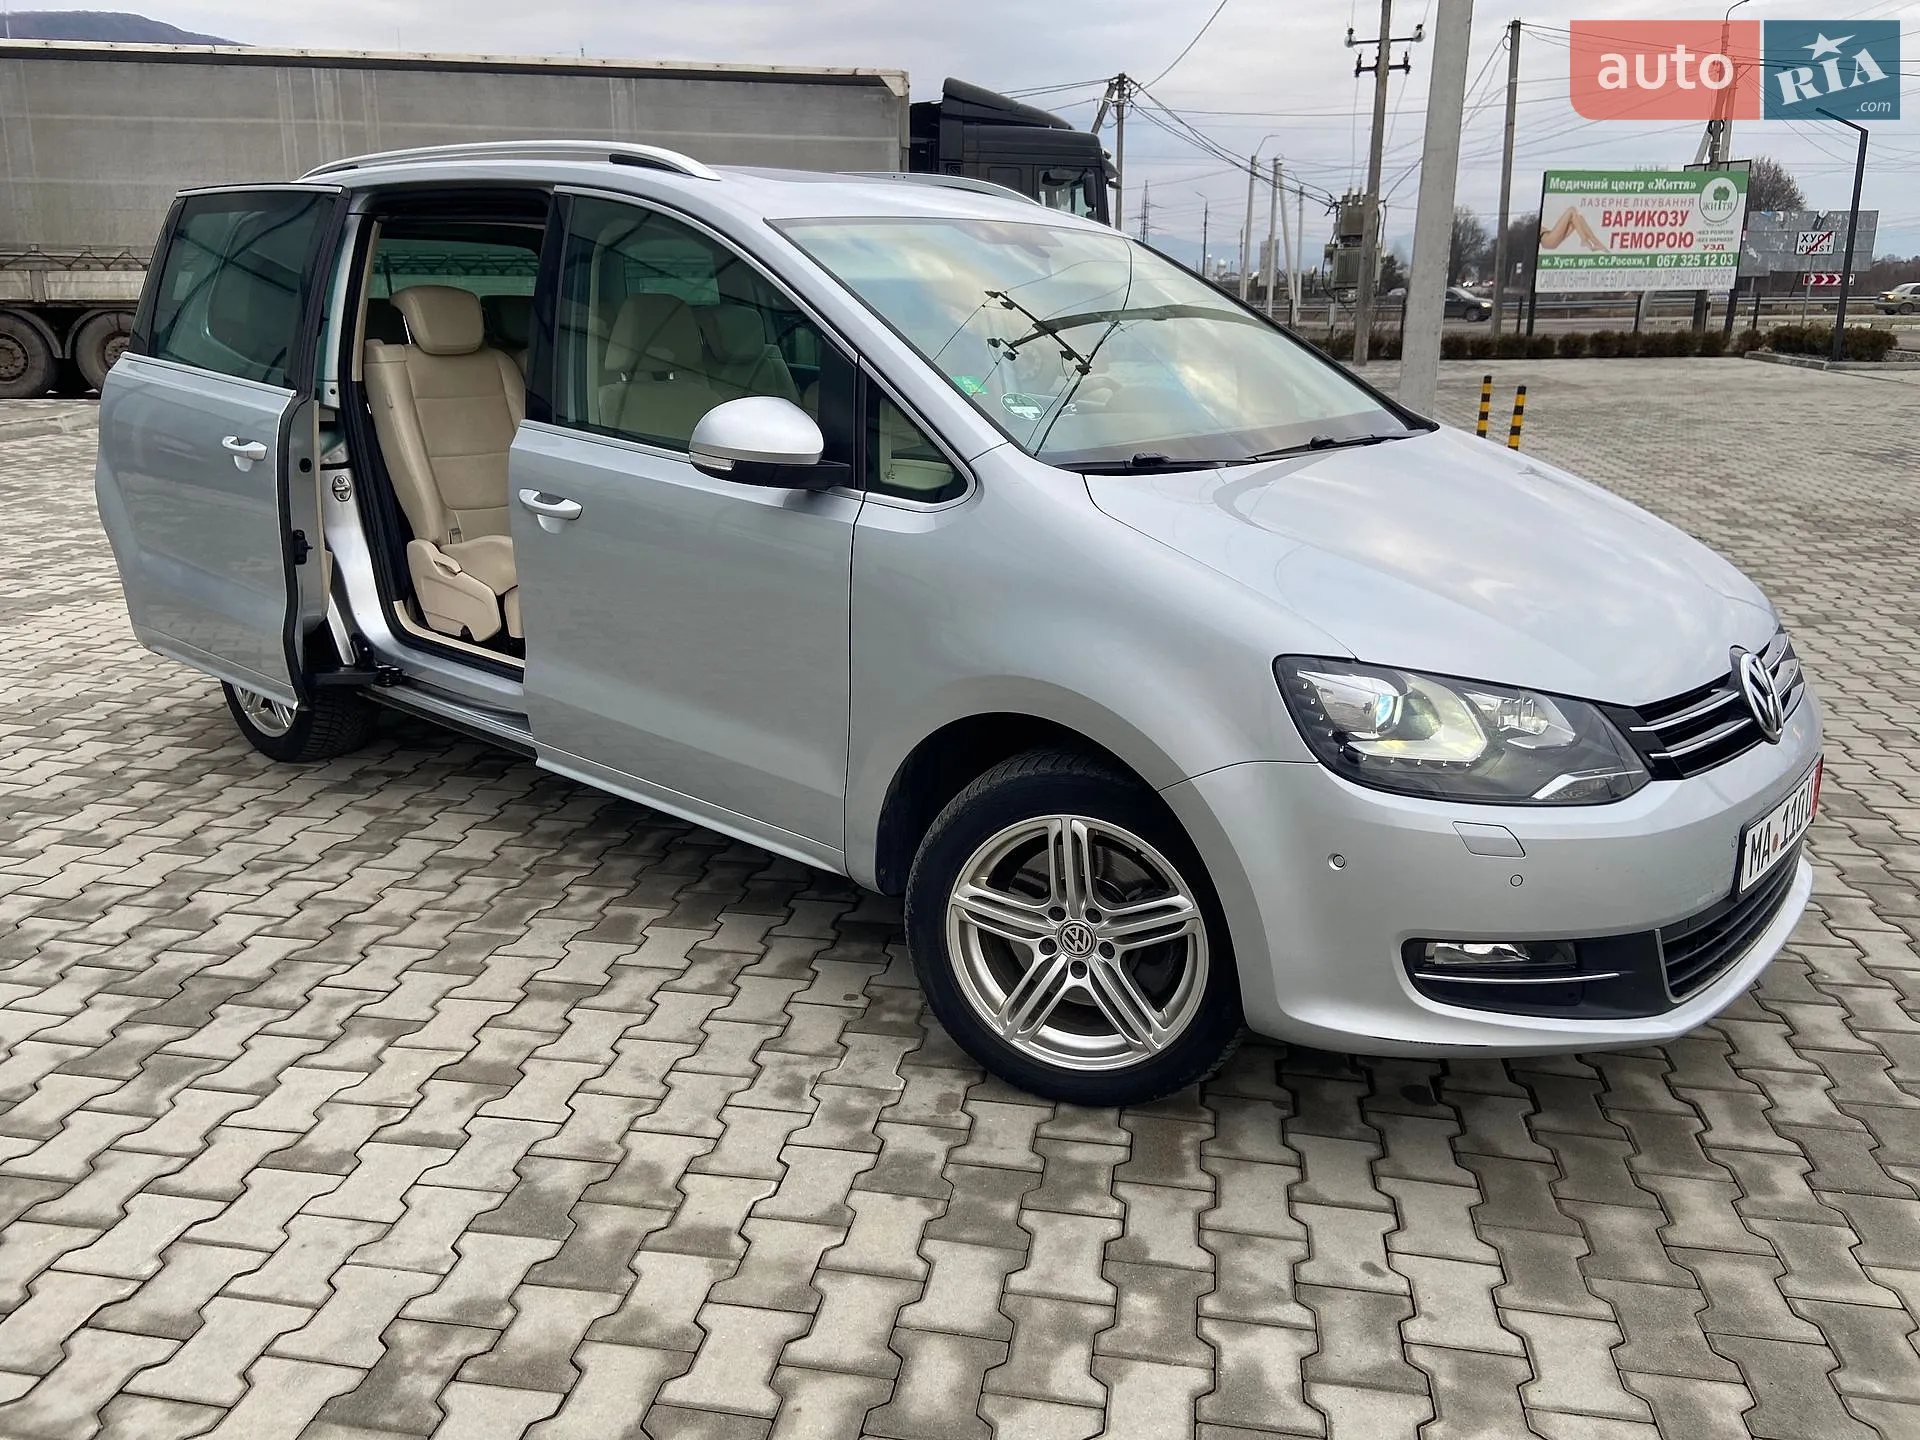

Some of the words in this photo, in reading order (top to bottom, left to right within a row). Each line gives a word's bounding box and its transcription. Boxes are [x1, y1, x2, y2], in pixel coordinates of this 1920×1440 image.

[1549, 177, 1608, 191] Медичний
[1611, 180, 1645, 192] центр
[1648, 178, 1697, 191] «Життя»
[1580, 198, 1629, 208] ЛАЗЕРНЕ
[1632, 198, 1695, 208] ЛІКУВАННЯ
[1601, 210, 1690, 228] ВАРИКОЗУ
[1609, 231, 1694, 249] ГЕМОРОЮ
[1801, 234, 1832, 243] ХУСТ
[1703, 243, 1725, 251] УЗД
[1553, 256, 1576, 268] Хуст,
[1578, 257, 1596, 268] вул.
[1656, 254, 1678, 267] 067
[1680, 254, 1701, 267] 325
[1705, 254, 1717, 266] 12
[1720, 254, 1734, 266] 03
[1749, 820, 1772, 879] MA
